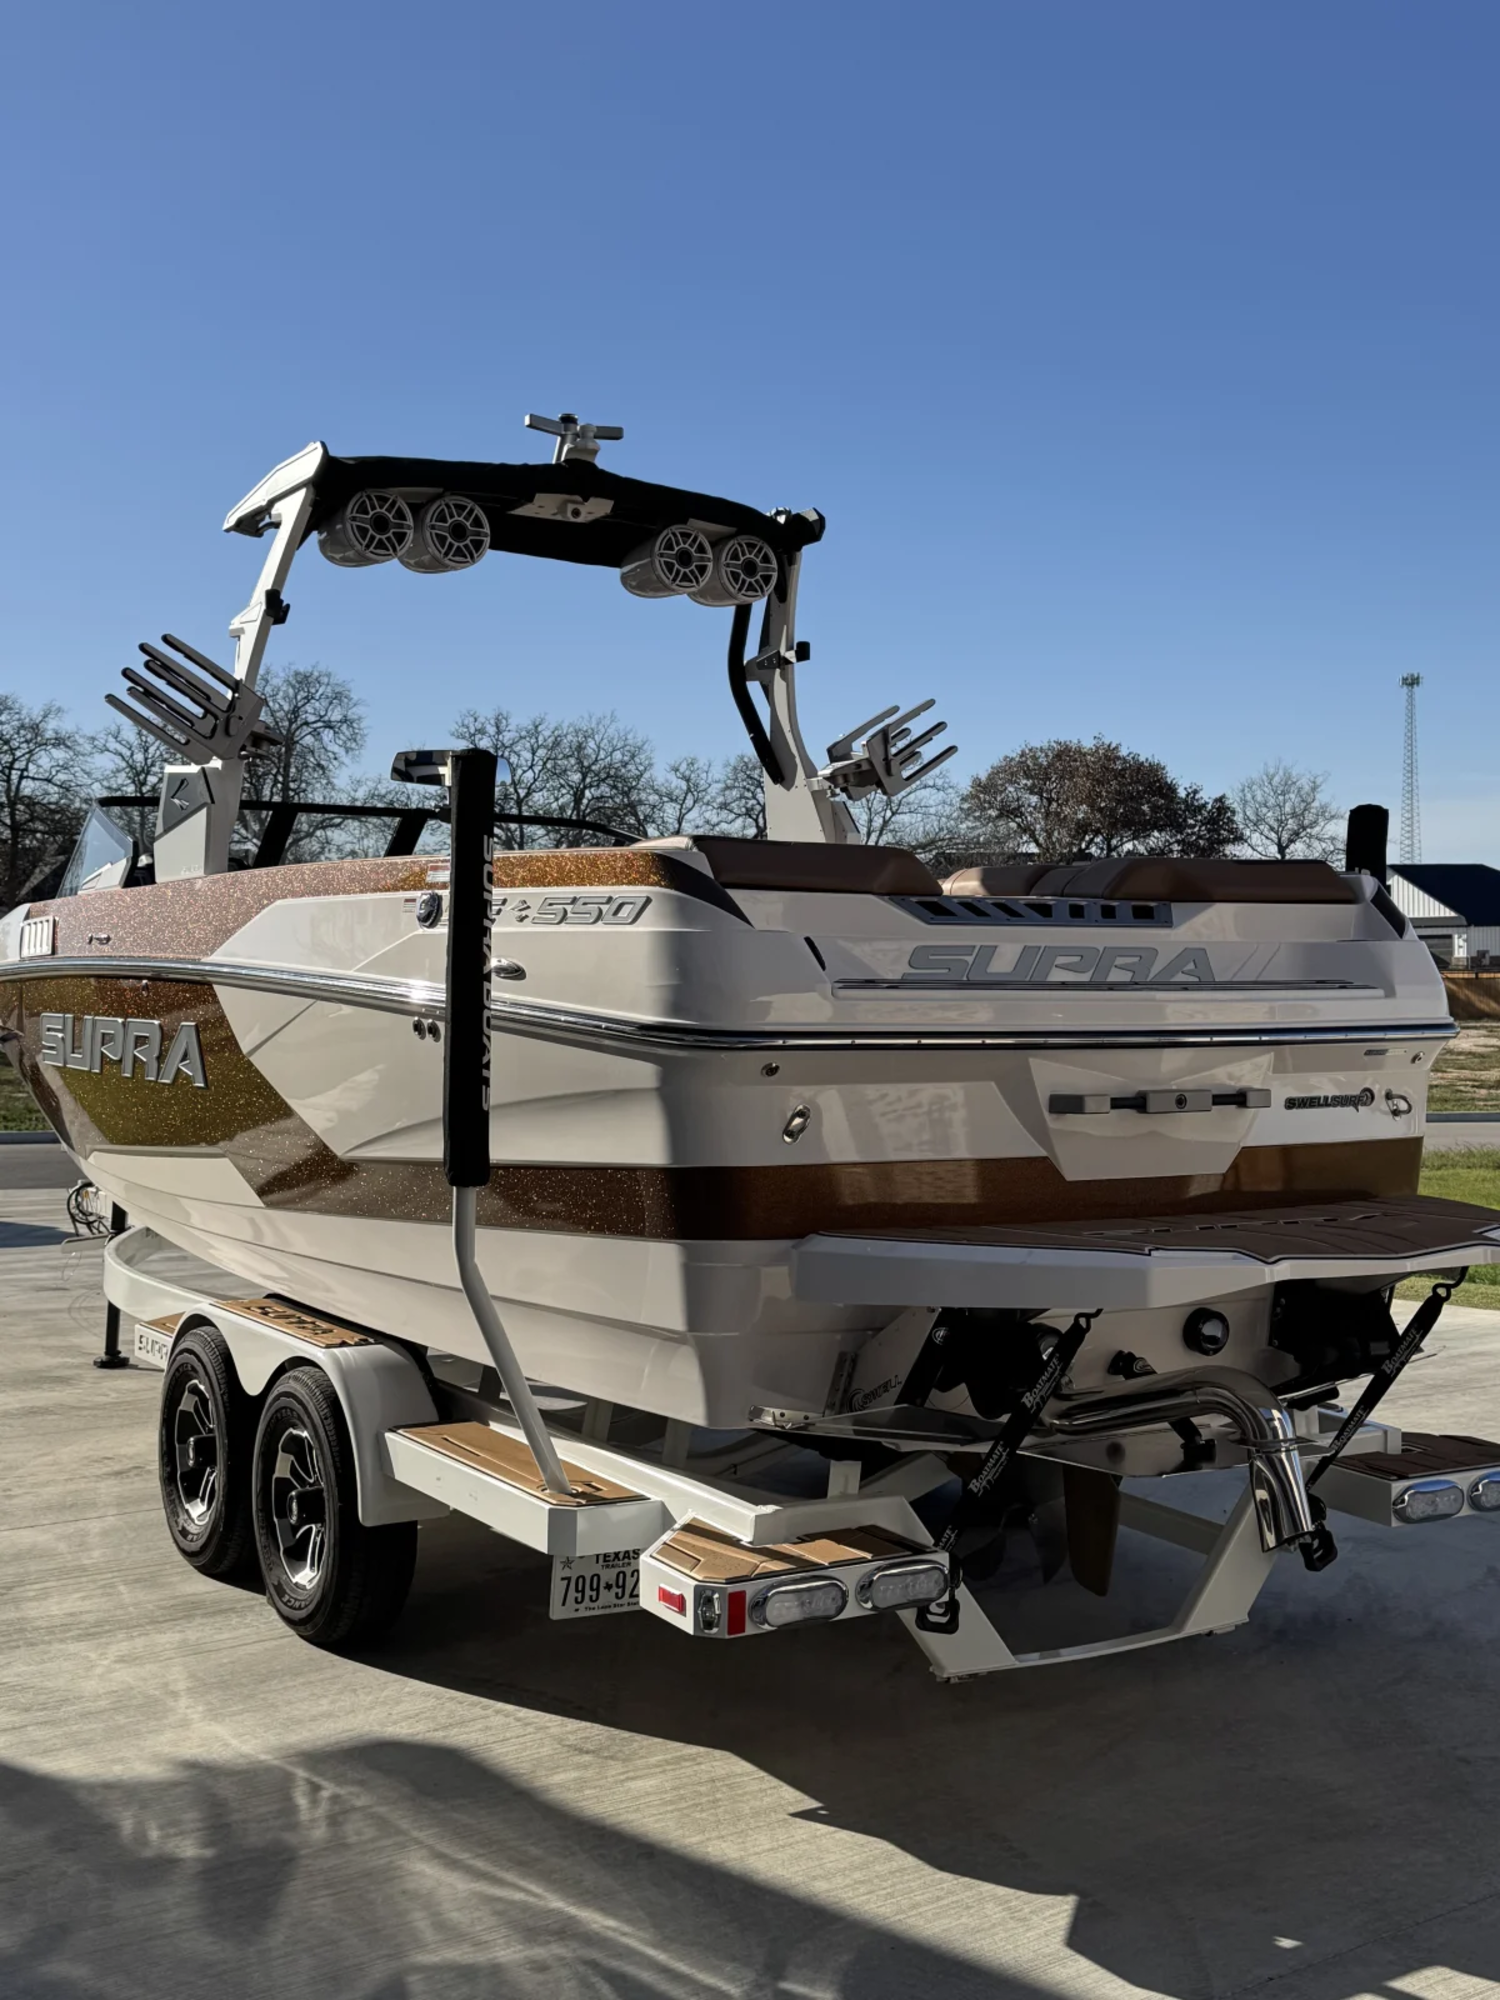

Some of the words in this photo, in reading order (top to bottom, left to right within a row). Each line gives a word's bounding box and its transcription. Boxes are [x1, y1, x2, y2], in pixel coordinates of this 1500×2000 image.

[531, 895, 653, 926] 550
[901, 944, 1216, 982] SUPRA
[40, 1012, 208, 1090] SUPRA
[138, 1334, 169, 1362] SUPR
[967, 1444, 1005, 1493] BOATMATE
[594, 1548, 640, 1565] TEXAS
[601, 1562, 632, 1570] TRAILER
[560, 1573, 601, 1607] 799
[615, 1569, 640, 1600] 92
